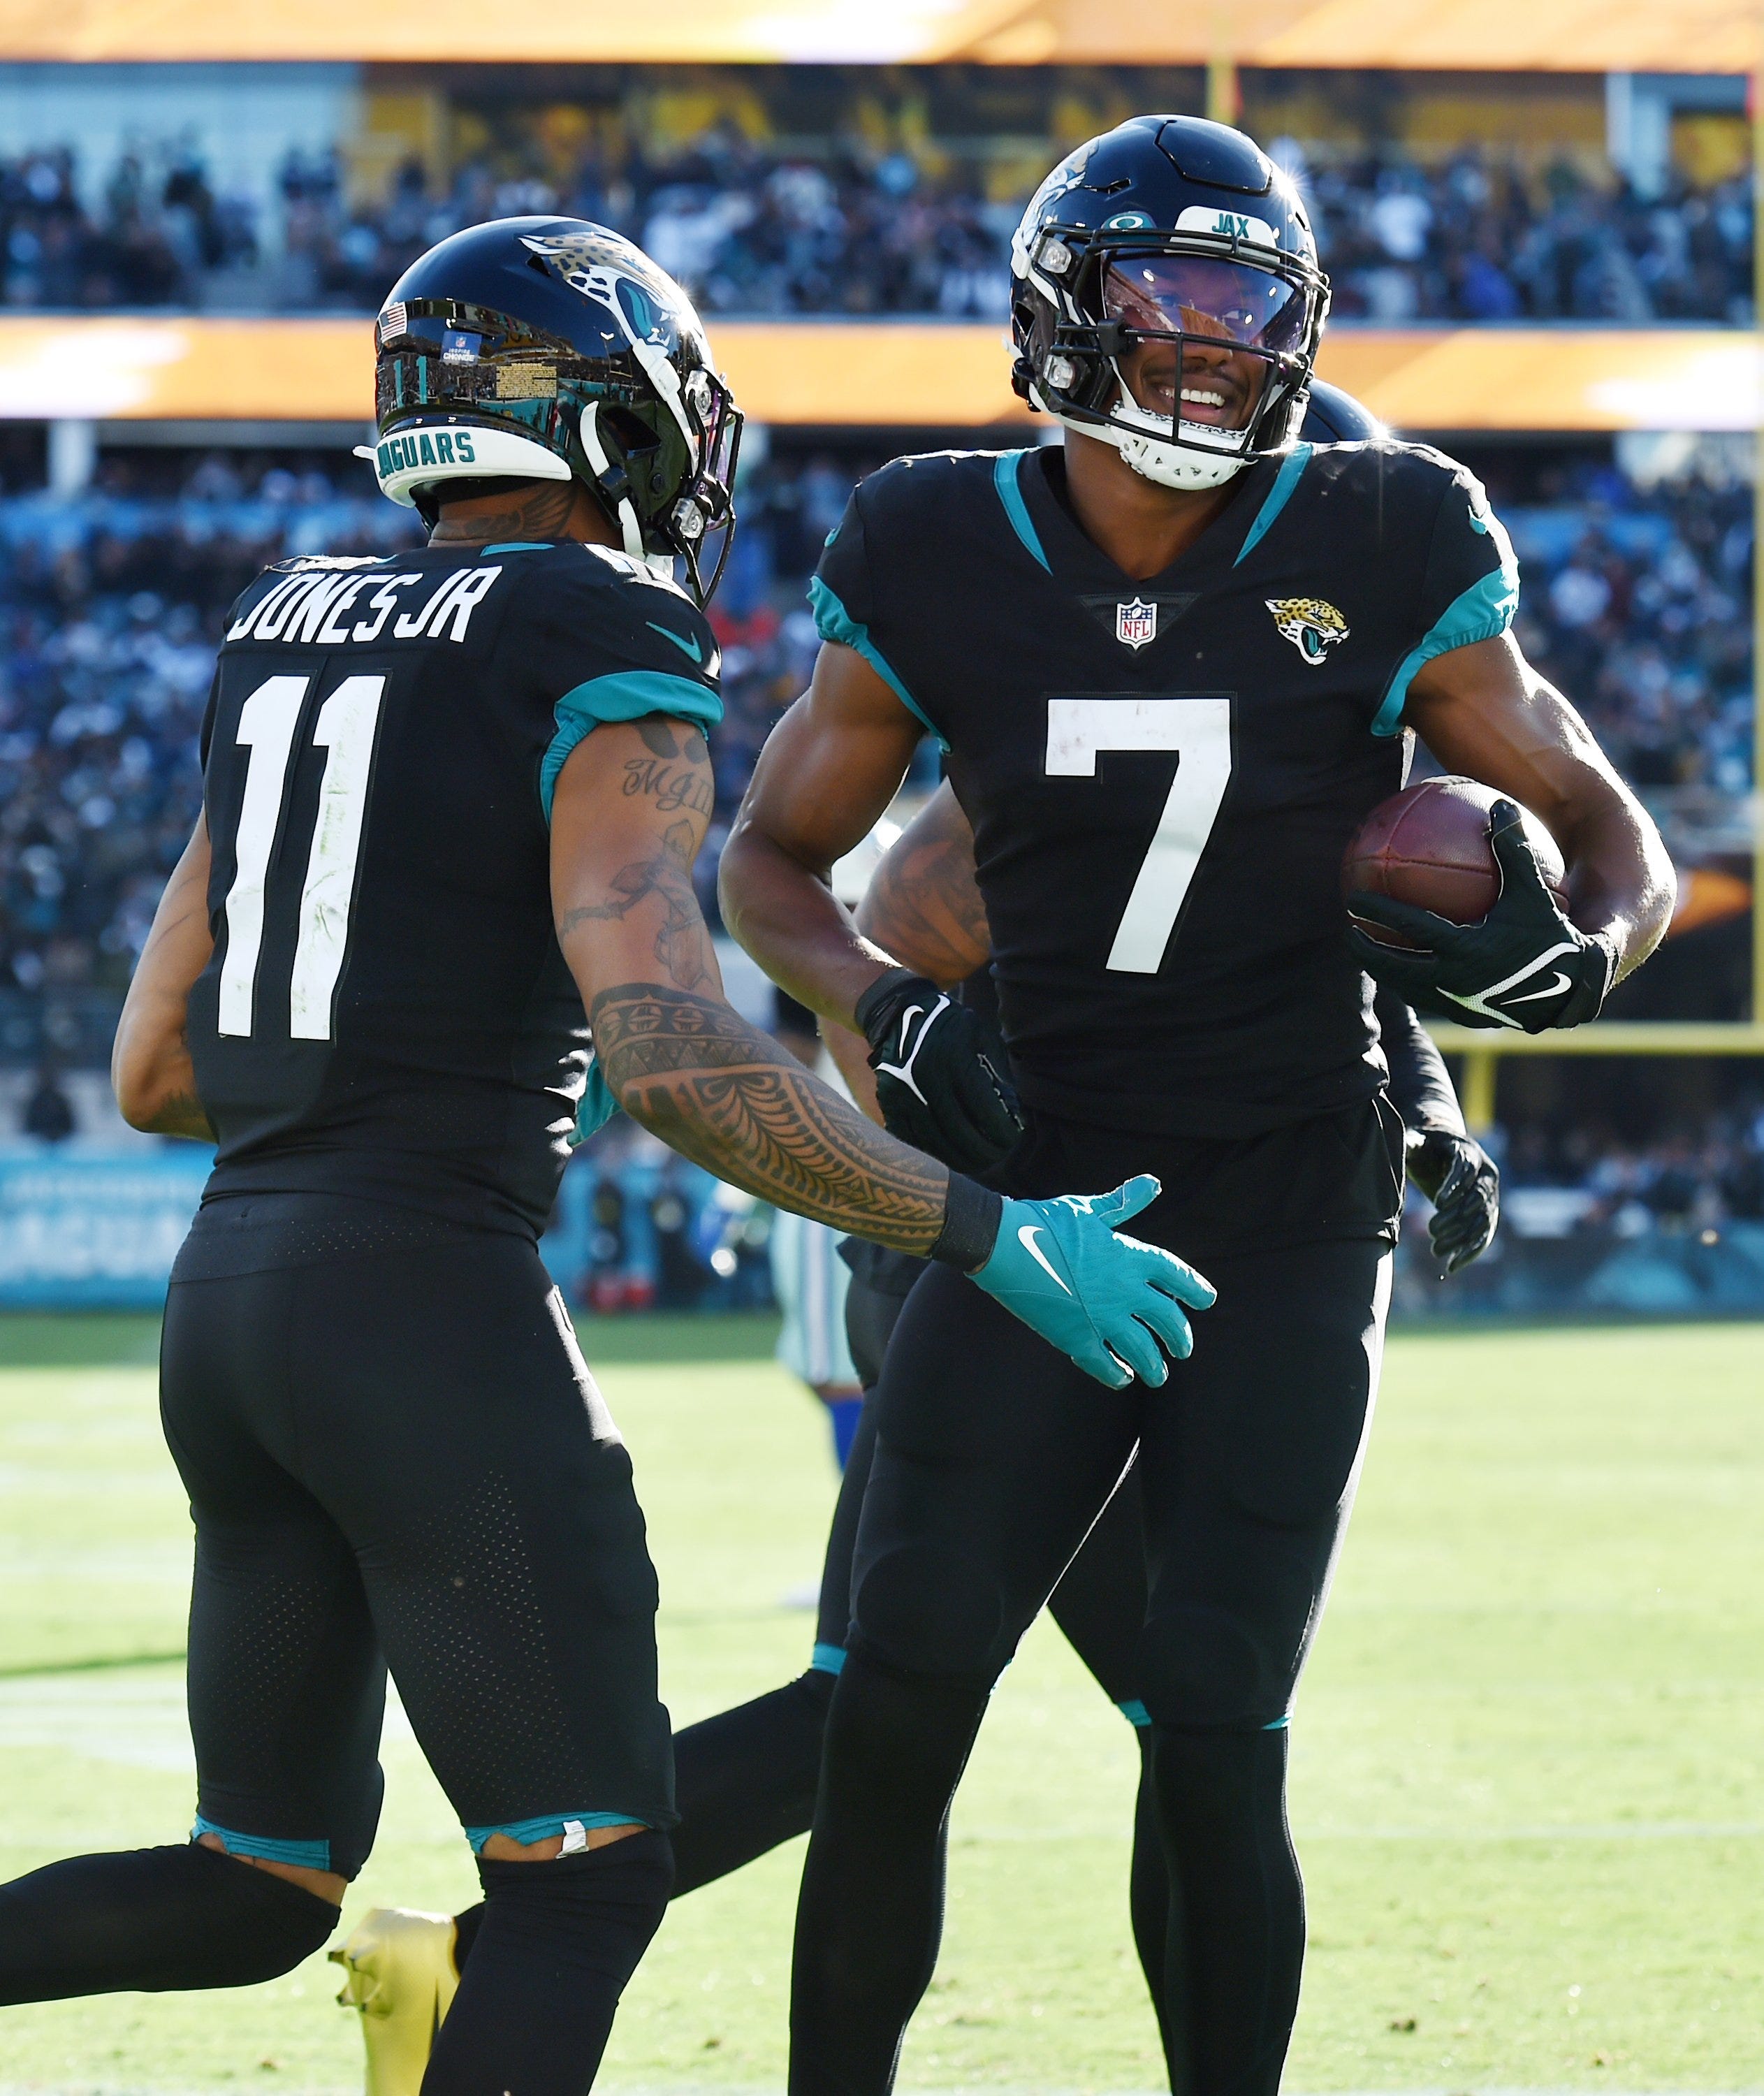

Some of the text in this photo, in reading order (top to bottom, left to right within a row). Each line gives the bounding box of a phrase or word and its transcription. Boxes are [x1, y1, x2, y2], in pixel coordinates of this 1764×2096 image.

[1211, 213, 1249, 238] JAX
[393, 355, 428, 408] 11
[443, 352, 475, 362] CHANGE
[377, 432, 475, 479] JAGUARS
[226, 565, 503, 644] JONES JR
[1123, 620, 1149, 639] NFL
[218, 675, 386, 1040] 11
[1045, 699, 1232, 974] 7
